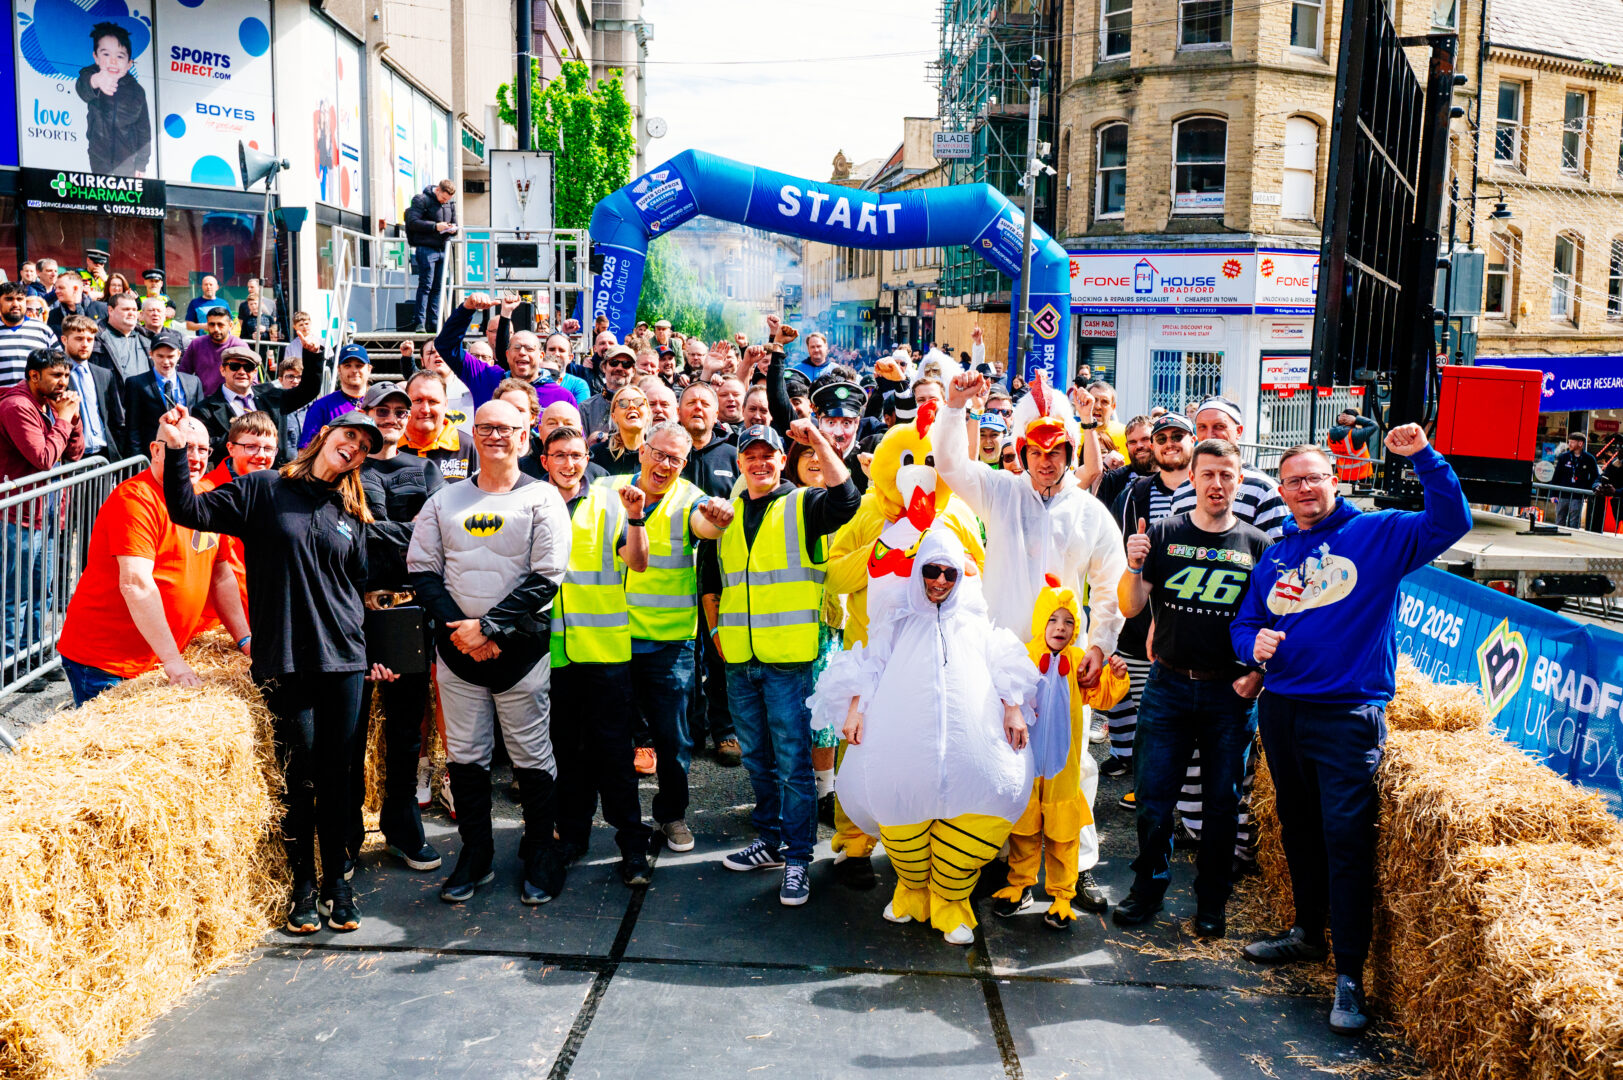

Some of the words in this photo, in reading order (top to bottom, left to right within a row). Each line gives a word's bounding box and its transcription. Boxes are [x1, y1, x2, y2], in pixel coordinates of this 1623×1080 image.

[170, 46, 230, 68] SPORTS
[34, 98, 72, 126] love
[196, 102, 255, 121] BOYES
[28, 127, 77, 142] SPORTS
[937, 134, 970, 142] BLADE
[69, 174, 143, 191] KIRKGATE
[70, 186, 143, 203] PHARMACY
[112, 204, 136, 214] 01274
[136, 206, 164, 216] 783334
[778, 185, 902, 236] START
[601, 256, 616, 288] 2025
[612, 259, 630, 304] Culture
[1083, 277, 1130, 286] FONE
[1160, 277, 1216, 286] HOUSE
[1276, 276, 1309, 286] FONE
[610, 306, 621, 320] of
[1560, 378, 1592, 390] CANCER
[1167, 544, 1196, 558] THE
[1196, 547, 1252, 566] DOCTOR
[1164, 566, 1248, 604] 46
[1164, 602, 1236, 616] VRFORTYSI
[1421, 605, 1463, 648] 2025
[1400, 635, 1450, 684] Culture
[1531, 655, 1623, 724] BRADF
[1524, 698, 1556, 746] UK
[1558, 717, 1613, 778] City
